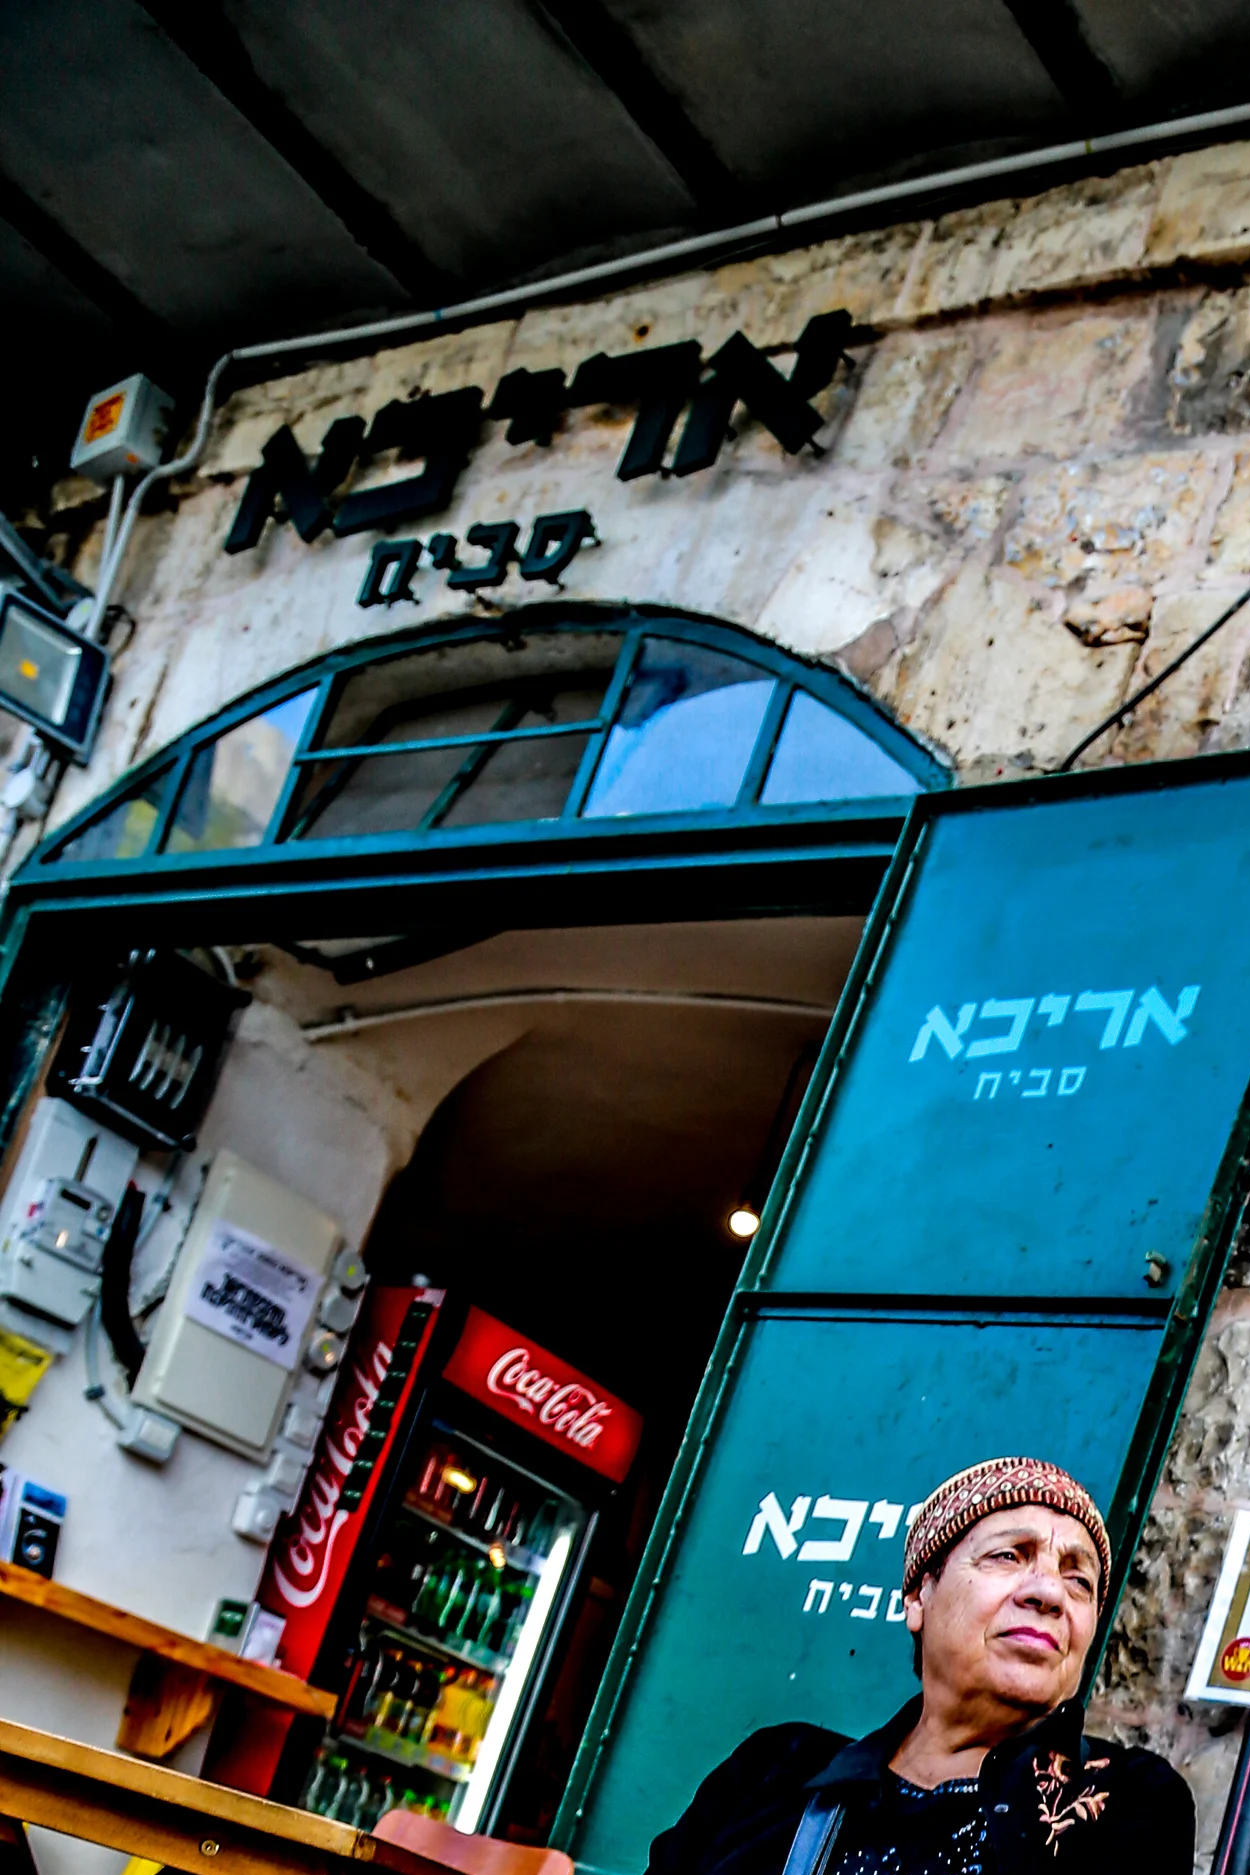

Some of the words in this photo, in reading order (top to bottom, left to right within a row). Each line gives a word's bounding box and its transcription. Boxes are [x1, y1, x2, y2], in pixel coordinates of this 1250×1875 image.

[225, 309, 853, 554] אריכא
[908, 985, 1201, 1062] אריכא
[973, 1066, 1088, 1100] סביח
[486, 1347, 613, 1450] Coca-Cola
[742, 1491, 925, 1561] יכא
